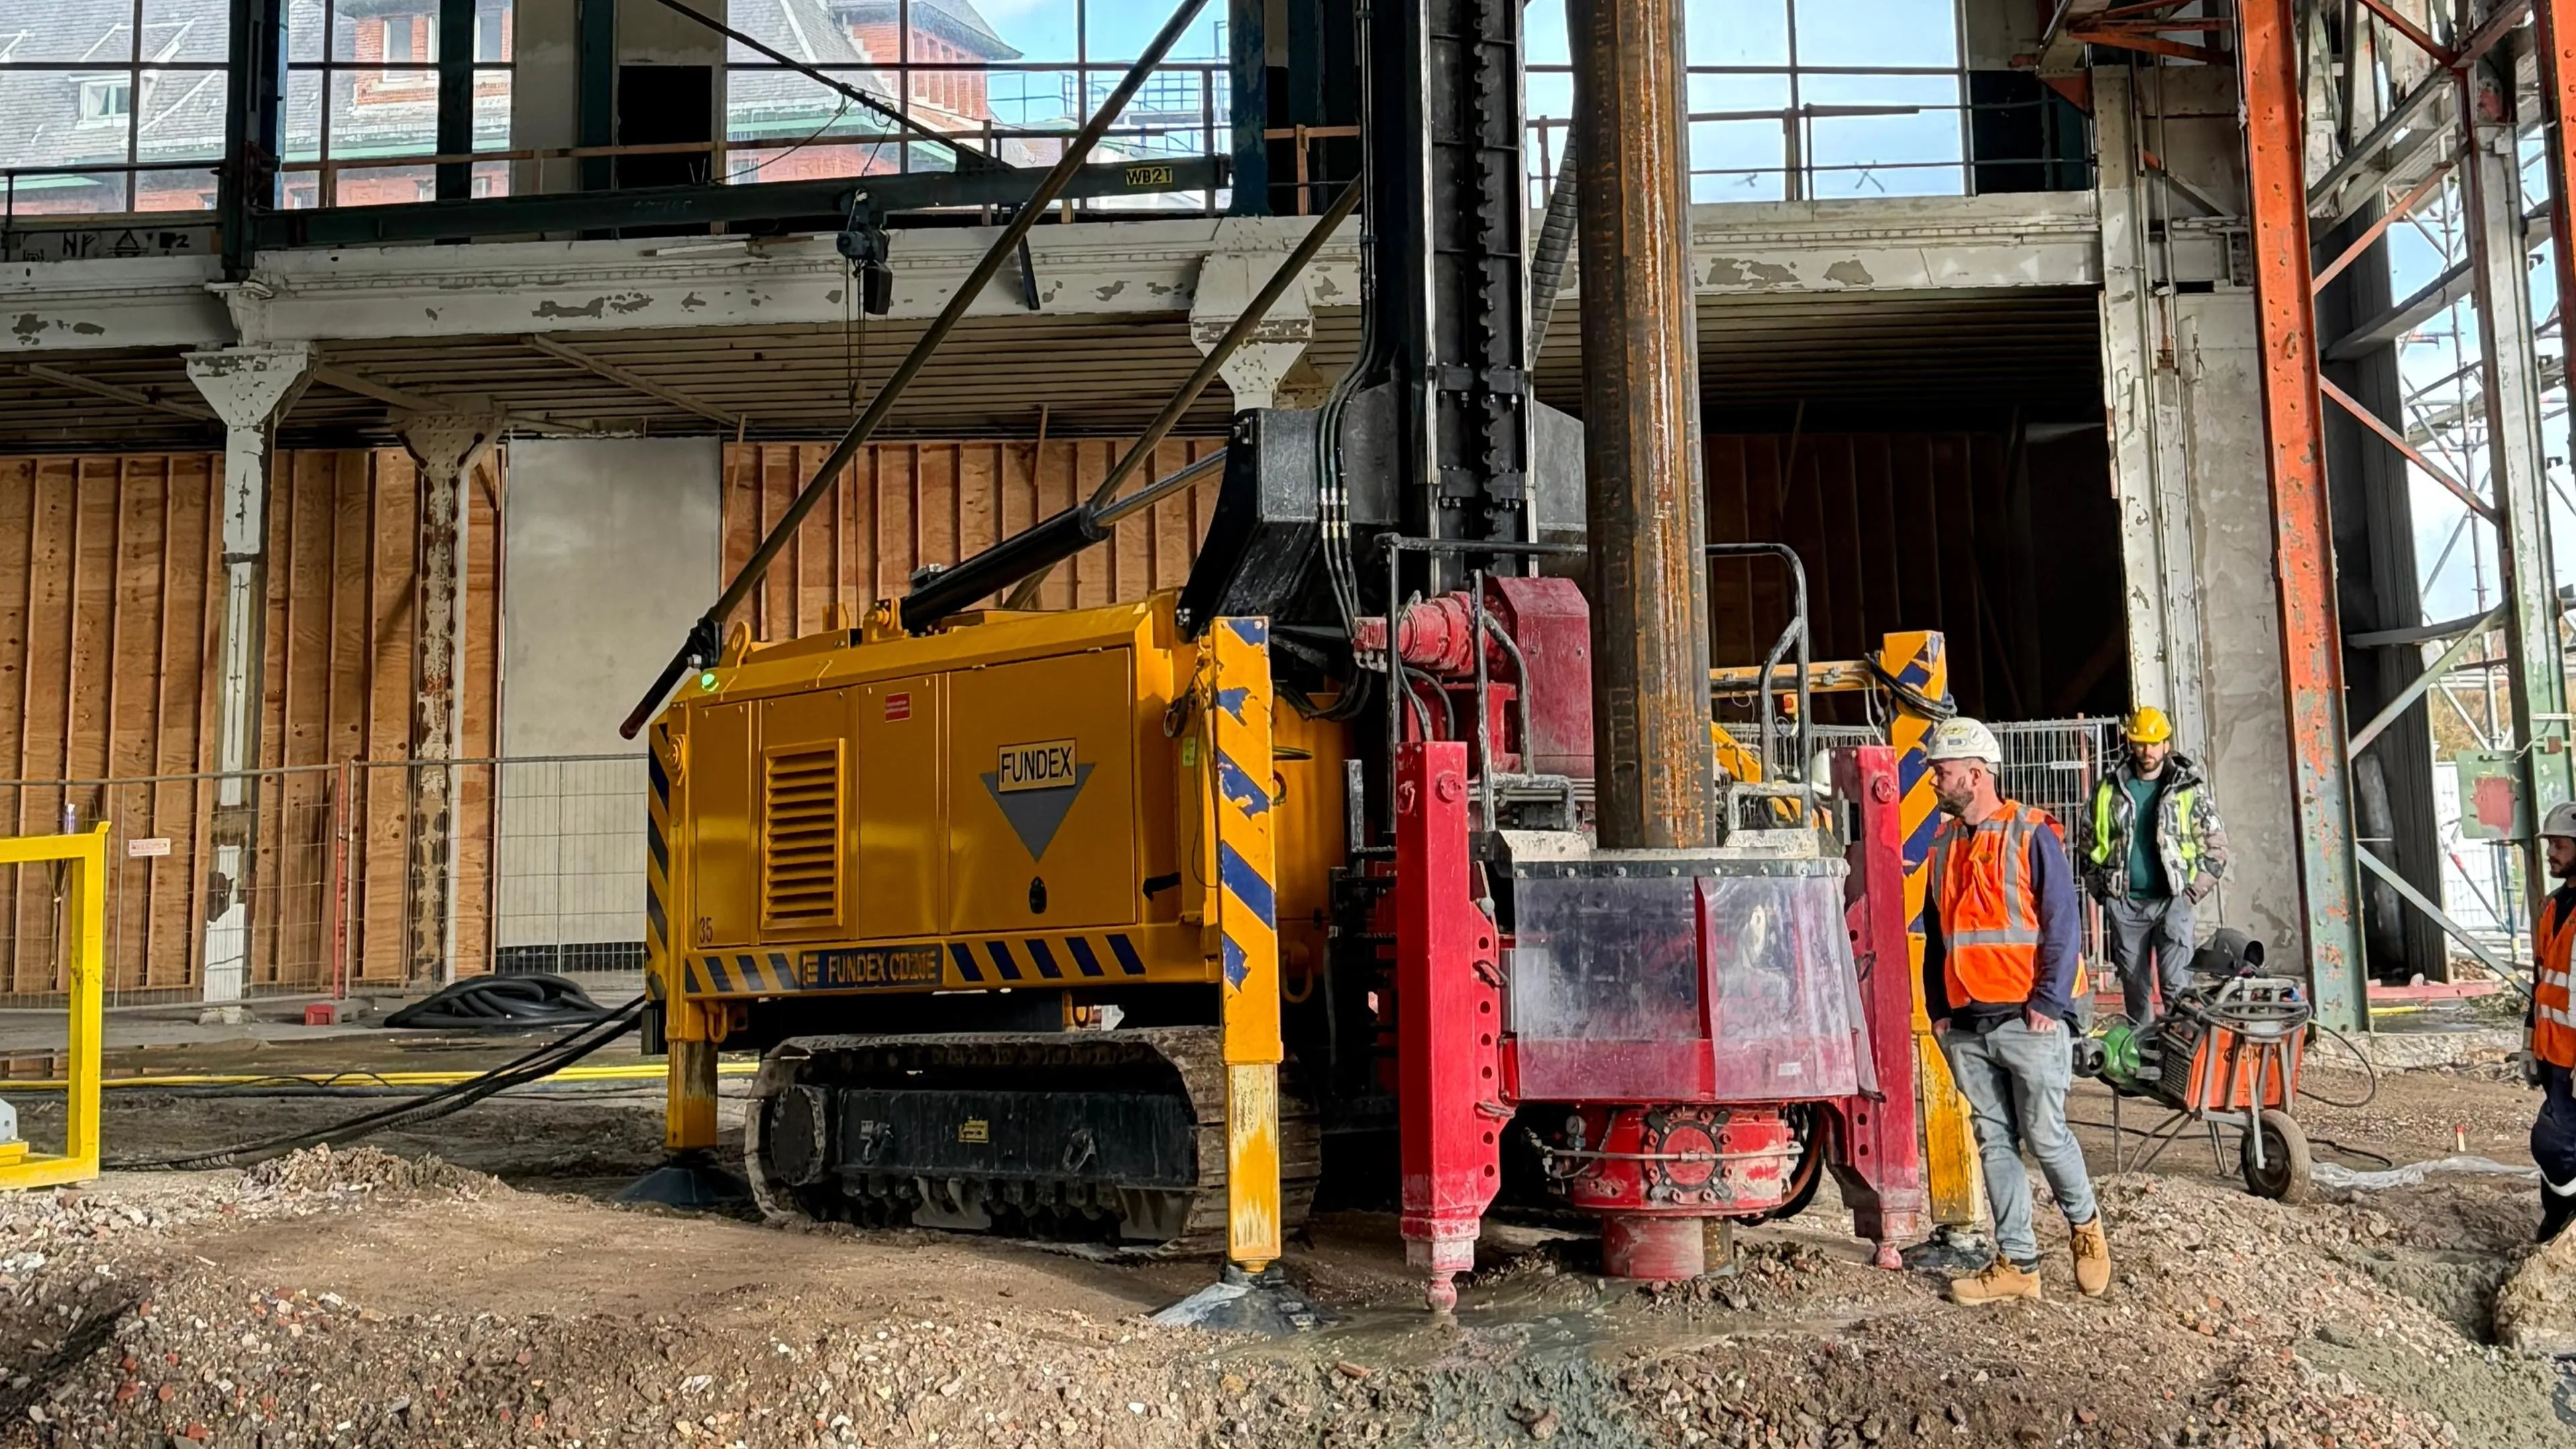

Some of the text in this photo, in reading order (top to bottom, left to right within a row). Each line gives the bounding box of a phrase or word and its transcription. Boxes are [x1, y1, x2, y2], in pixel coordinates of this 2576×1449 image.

[1001, 746, 1073, 784] FUNDEX
[700, 917, 712, 943] 35
[828, 953, 887, 983] FUNDEX
